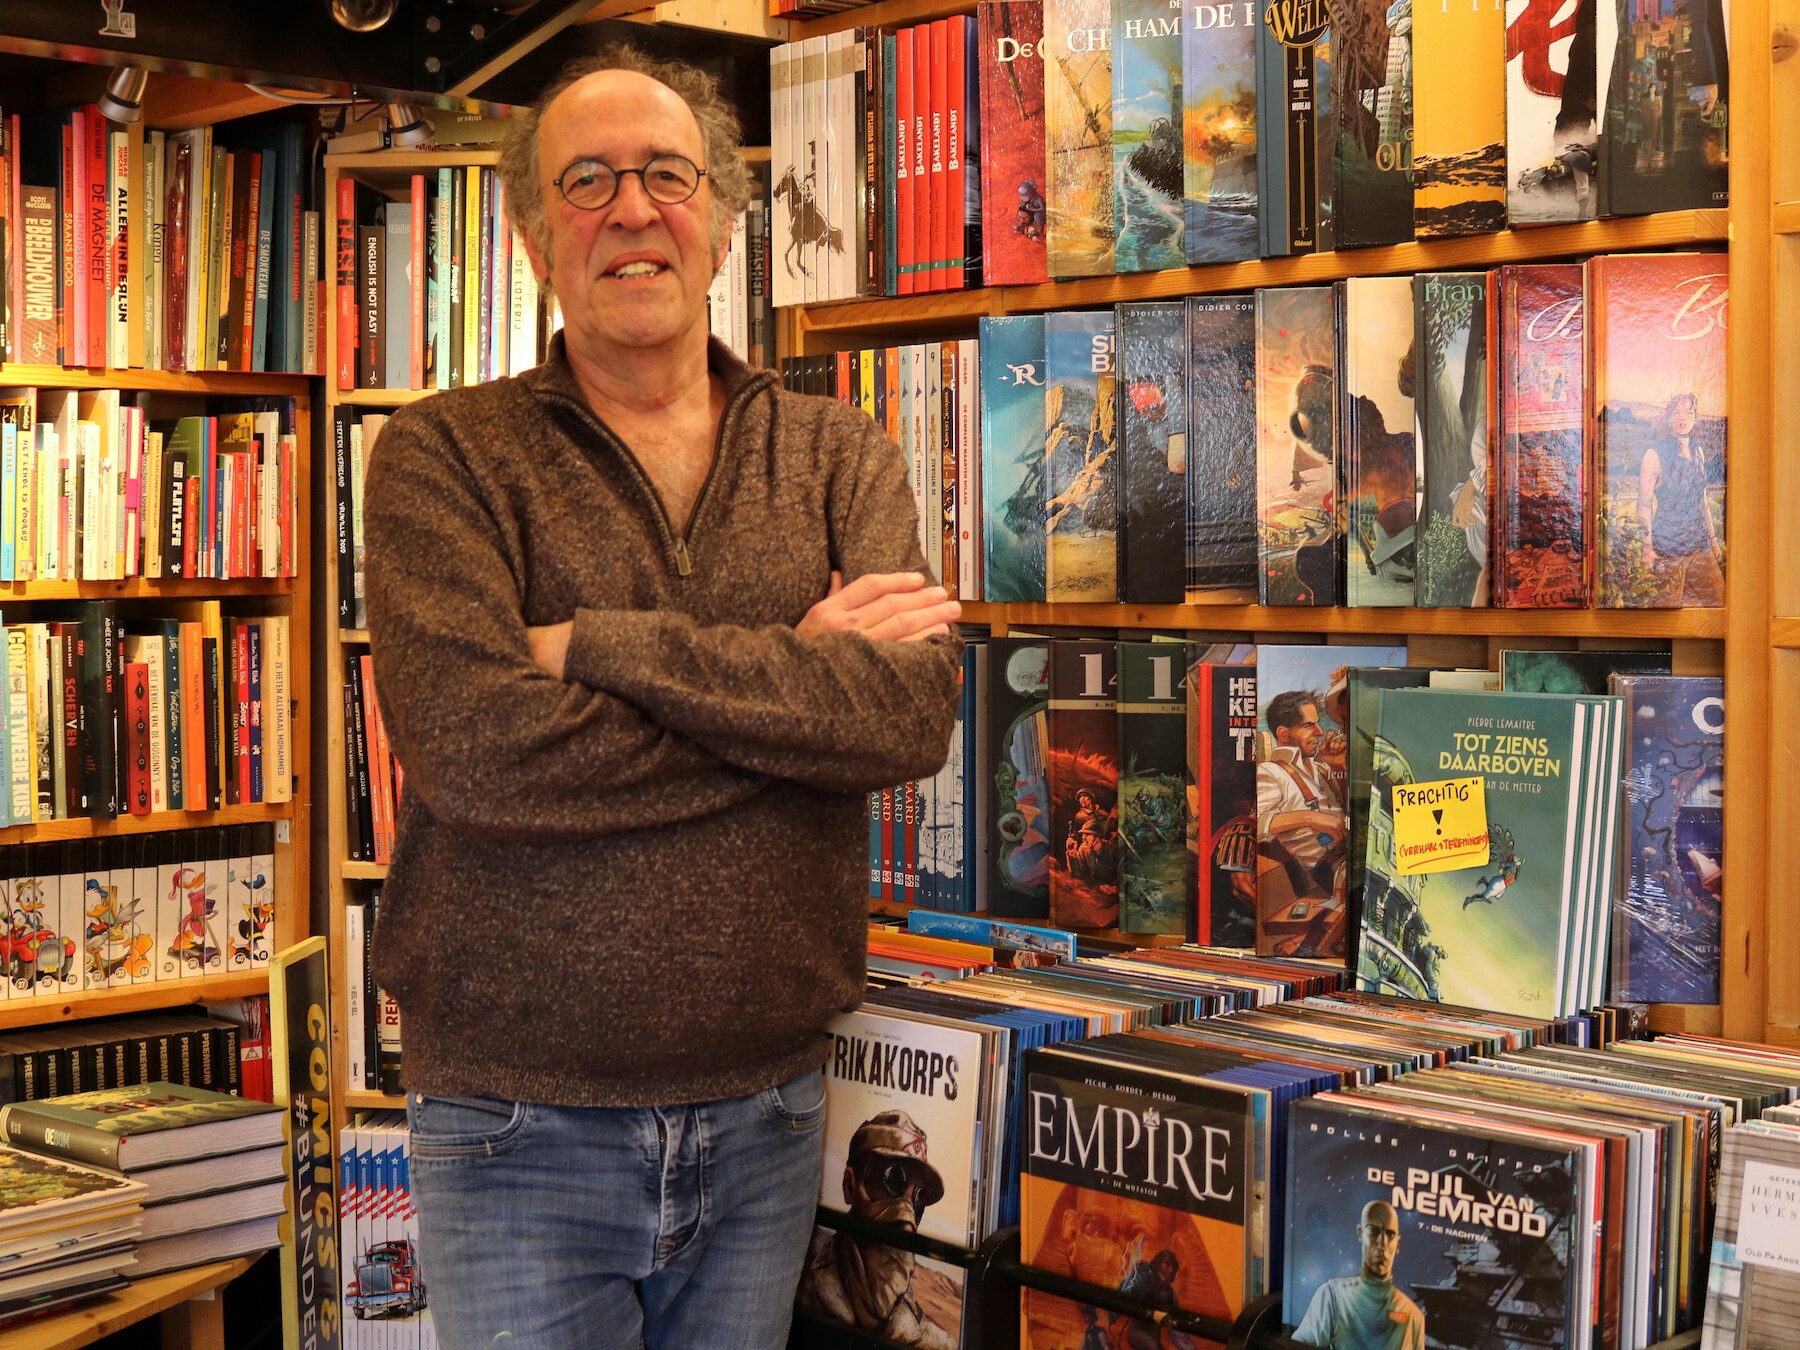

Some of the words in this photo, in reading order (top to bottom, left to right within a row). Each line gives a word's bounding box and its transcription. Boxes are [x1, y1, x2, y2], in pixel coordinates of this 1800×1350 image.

[1194, 4, 1236, 30] DE
[997, 37, 1034, 62] De
[898, 119, 907, 179] BAKELANDT
[915, 116, 924, 175] BAKELANDT
[932, 112, 941, 172] BAKELANDT
[949, 109, 958, 170] BAKELANDT
[92, 184, 103, 202] DE
[294, 194, 300, 206] DE
[118, 188, 127, 243] ALLEEN
[64, 213, 72, 252] SPAANS
[92, 207, 104, 283] MAGNEET
[153, 223, 167, 263] Kongo
[261, 230, 270, 241] DE
[119, 245, 127, 258] IN
[368, 237, 376, 274] ENGLISH
[25, 226, 52, 320] BEELDHOUWER
[65, 256, 73, 287] ROOD
[258, 244, 270, 299] SMOKKELAAR
[514, 260, 523, 276] DE
[751, 233, 763, 296] TRASHED
[368, 278, 376, 286] IS
[1424, 282, 1487, 303] Fran
[368, 288, 377, 307] NOT
[514, 282, 523, 330] LOTERIJ
[1198, 304, 1231, 312] DIDIER
[369, 310, 377, 332] EASY
[841, 361, 844, 371] 1
[852, 359, 856, 369] 2
[865, 359, 868, 368] 3
[878, 357, 882, 367] 4
[889, 355, 893, 365] 5
[902, 355, 906, 364] 6
[916, 354, 919, 364] 7
[931, 352, 934, 362] 9
[171, 482, 182, 546] FLATLIFE
[150, 670, 158, 682] HET
[275, 662, 282, 670] ZE
[9, 694, 27, 716] DE
[65, 678, 77, 746] SCHERVEN
[276, 696, 284, 732] ALLEMAAL
[151, 715, 159, 728] VAN
[1467, 717, 1493, 728] PIERRE
[1497, 719, 1536, 730] LEMAITRE
[152, 731, 160, 740] DE
[1453, 732, 1491, 753] TOT
[1494, 735, 1549, 757] ZIENS
[11, 719, 29, 781] TWEEDE
[152, 742, 161, 783] GOSCINNY'S
[1438, 751, 1561, 778] DAARBOVEN
[1499, 782, 1510, 791] DE
[12, 783, 30, 817] KUS
[202, 1033, 211, 1085] PREMIUM
[228, 1032, 236, 1083] PREMIUM
[1116, 1085, 1143, 1096] KORDEY
[1153, 1091, 1176, 1102] DESKO
[307, 1003, 336, 1269] COMICS
[1030, 1090, 1234, 1202] EMPIRE
[1311, 1123, 1398, 1147] BOLLÉE
[1448, 1149, 1542, 1174] GRIFFO
[1126, 1183, 1158, 1197] MUTATOR
[1367, 1167, 1395, 1186] DE
[1407, 1167, 1475, 1201] PIJL
[1487, 1190, 1535, 1213] VAN
[1392, 1186, 1547, 1238] NEMROD
[1751, 1203, 1797, 1220] YVES
[1431, 1225, 1444, 1234] DE
[1445, 1228, 1488, 1243] NACHTEN
[320, 1298, 337, 1342] &
